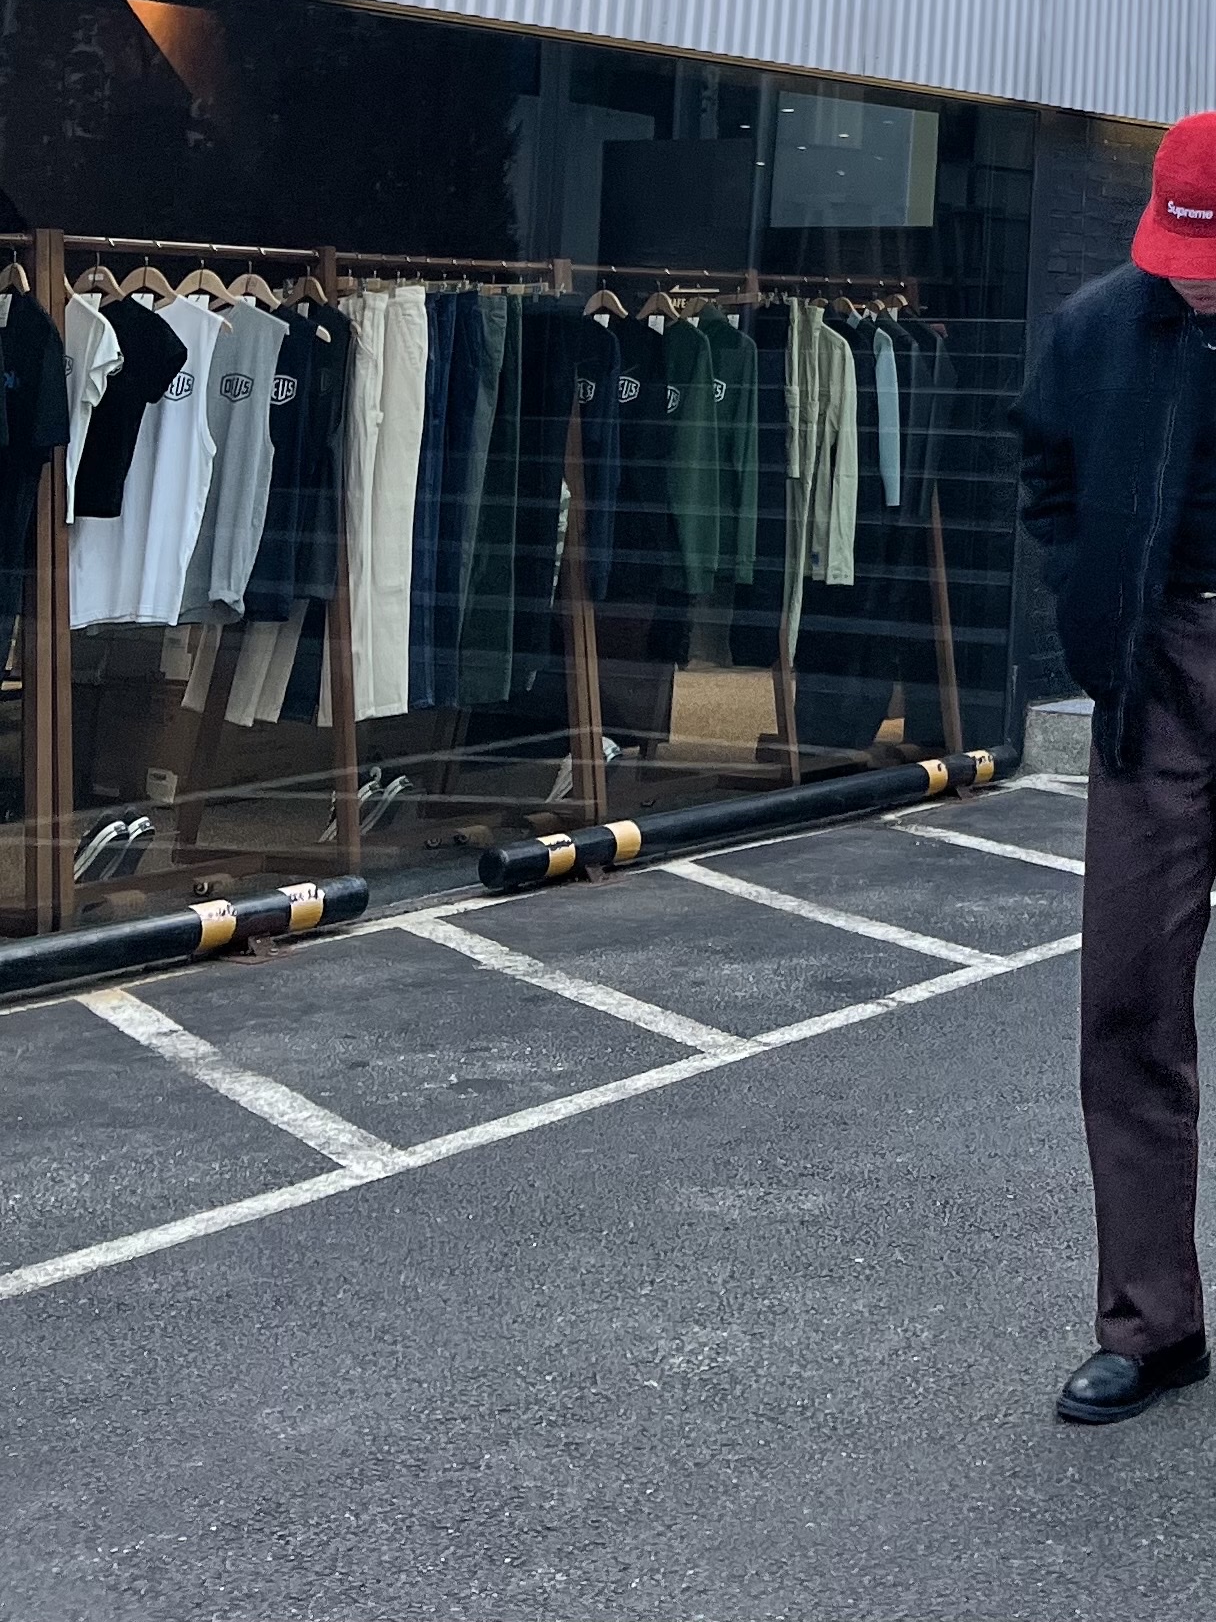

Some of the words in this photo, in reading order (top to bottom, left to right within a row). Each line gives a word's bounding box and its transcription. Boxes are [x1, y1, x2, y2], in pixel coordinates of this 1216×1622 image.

[1167, 200, 1214, 220] Supreme
[169, 375, 192, 397] EUS
[272, 378, 294, 401] EUS
